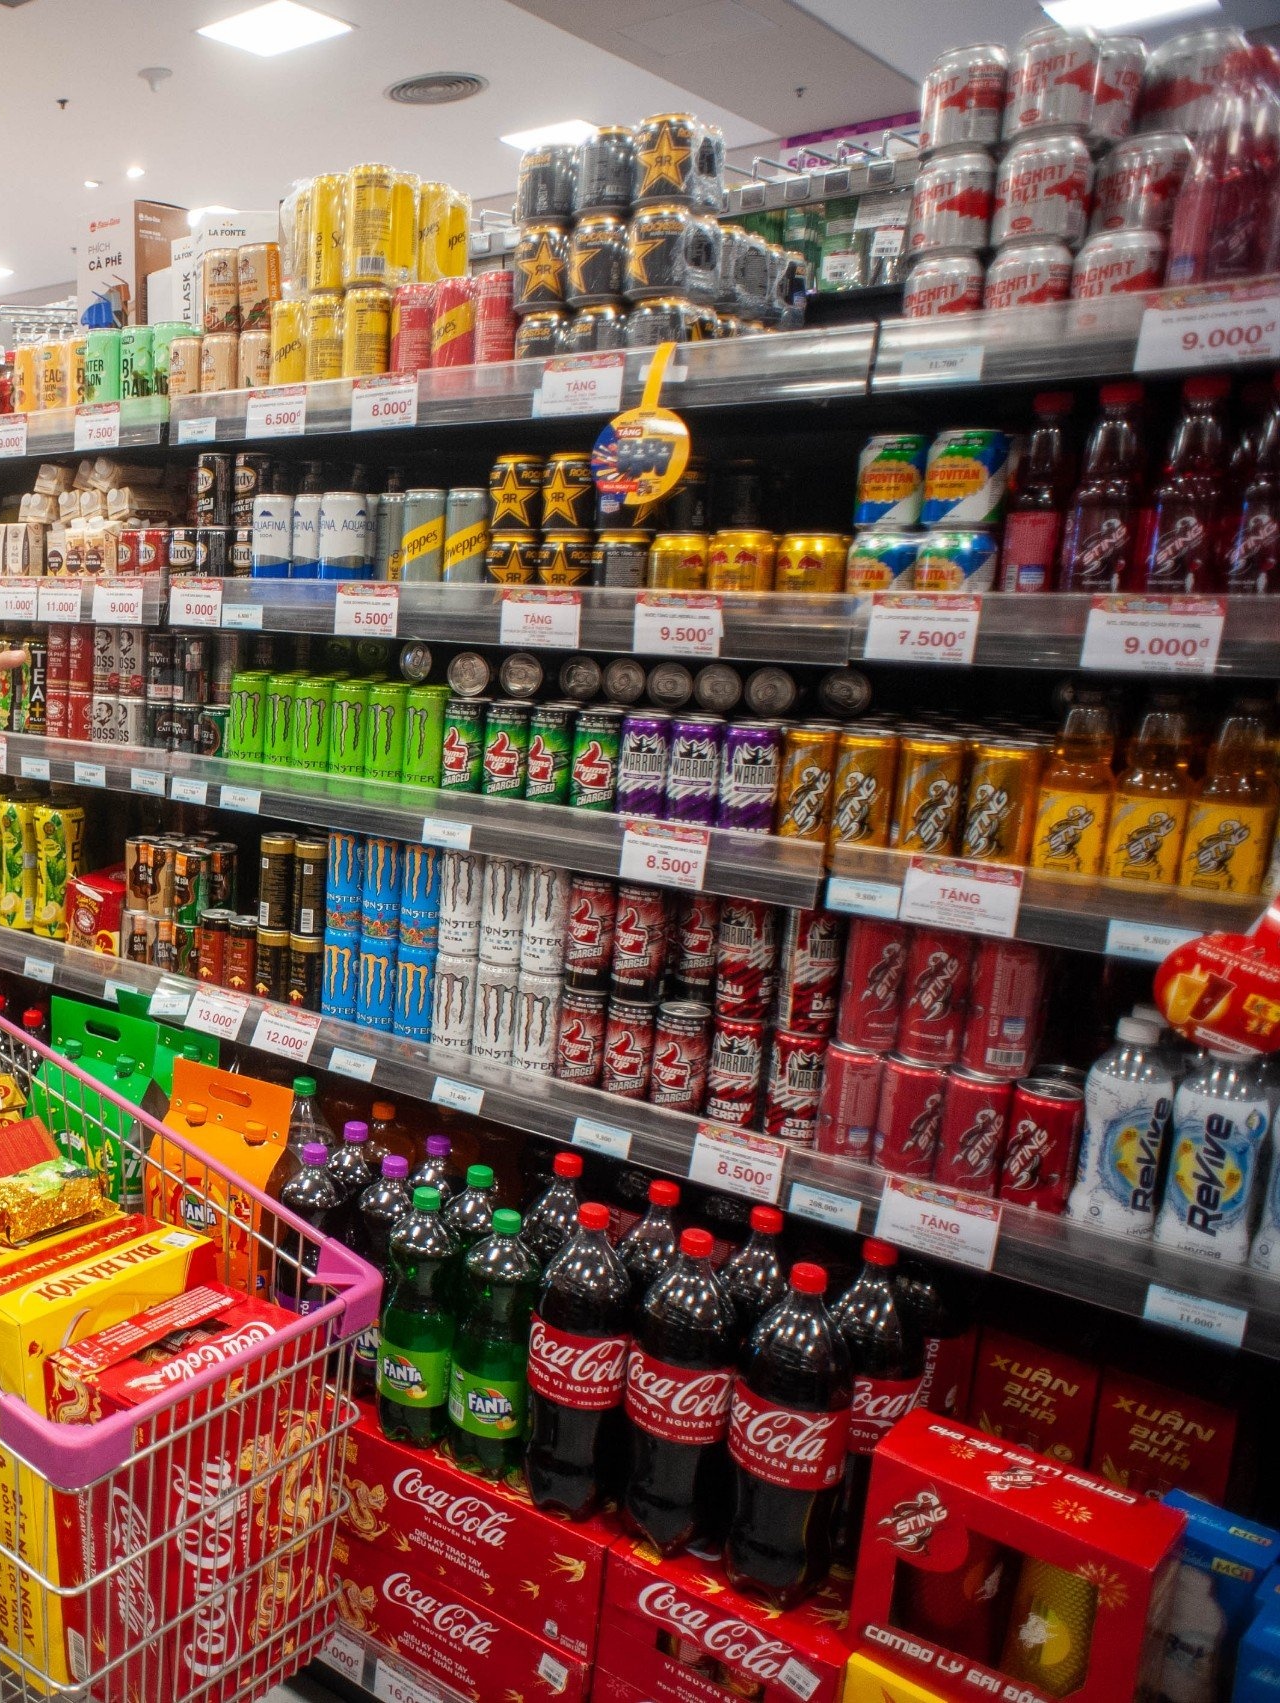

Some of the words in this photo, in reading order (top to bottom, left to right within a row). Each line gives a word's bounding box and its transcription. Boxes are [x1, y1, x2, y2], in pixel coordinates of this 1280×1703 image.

[208, 229, 219, 237] LA
[220, 228, 247, 237] FONTE
[89, 257, 103, 272] CÀ
[105, 252, 123, 268] PHÊ
[183, 271, 192, 321] FLASK
[1182, 320, 1277, 351] 9.000đ
[565, 380, 598, 394] TẶNG
[265, 410, 302, 426] 6.500đ
[371, 399, 413, 417] 8.000đ
[4, 599, 34, 611] 11.000đ
[46, 600, 78, 612] 11.000đ
[110, 601, 139, 614] 9.000đ
[185, 603, 218, 617] 9.000đ
[354, 611, 394, 626] 5.500đ
[524, 614, 553, 626] TẶNG
[660, 625, 714, 644] 9.500đ
[898, 630, 967, 647] 7.500đ
[1124, 636, 1210, 657] 9.000đ
[623, 751, 664, 773] WARRIOR
[673, 756, 715, 778] WARRIOR
[486, 778, 520, 794] CHARGED
[577, 789, 612, 805] CHARGED
[646, 854, 698, 875] 8.500đ
[939, 887, 981, 905] TẶNG
[197, 1007, 237, 1029] 13.000đ
[265, 1029, 308, 1050] 12.000đ
[608, 1078, 644, 1092] CHARGED
[655, 1090, 692, 1104] CHARGED
[707, 1099, 752, 1113] STRAW
[706, 1108, 744, 1122] BERRY
[716, 1160, 772, 1186] 8.500đ
[919, 1212, 961, 1235] TẶNG
[383, 1356, 422, 1383] FANTA
[989, 1353, 1080, 1398] XUÂN
[566, 1381, 610, 1394] NGUYÊN
[467, 1391, 513, 1415] FANTA
[1002, 1396, 1057, 1425] PHÁ
[665, 1417, 713, 1429] NGUYÊN
[1111, 1395, 1216, 1443] XUÂN
[741, 1442, 788, 1472] NGUYÊN
[792, 1462, 818, 1475] BẢN
[1127, 1439, 1190, 1472] PHÁ
[1063, 1473, 1137, 1505] COMBO
[392, 1467, 516, 1549] Coca-Cola
[432, 1518, 461, 1539] NGUYÊN
[895, 1504, 949, 1536] STING
[427, 1540, 444, 1556] MAY
[445, 1542, 467, 1560] TRAO
[467, 1554, 482, 1568] TAY
[19, 1582, 36, 1648] NGAY
[382, 1572, 500, 1656] Coca-Cola
[433, 1645, 453, 1663] TRAO
[453, 1658, 469, 1675] TAY
[864, 1623, 934, 1664] COMBO
[935, 1655, 964, 1674] LY
[966, 1667, 1001, 1694] GAI
[677, 1668, 721, 1697] NGUYÊN
